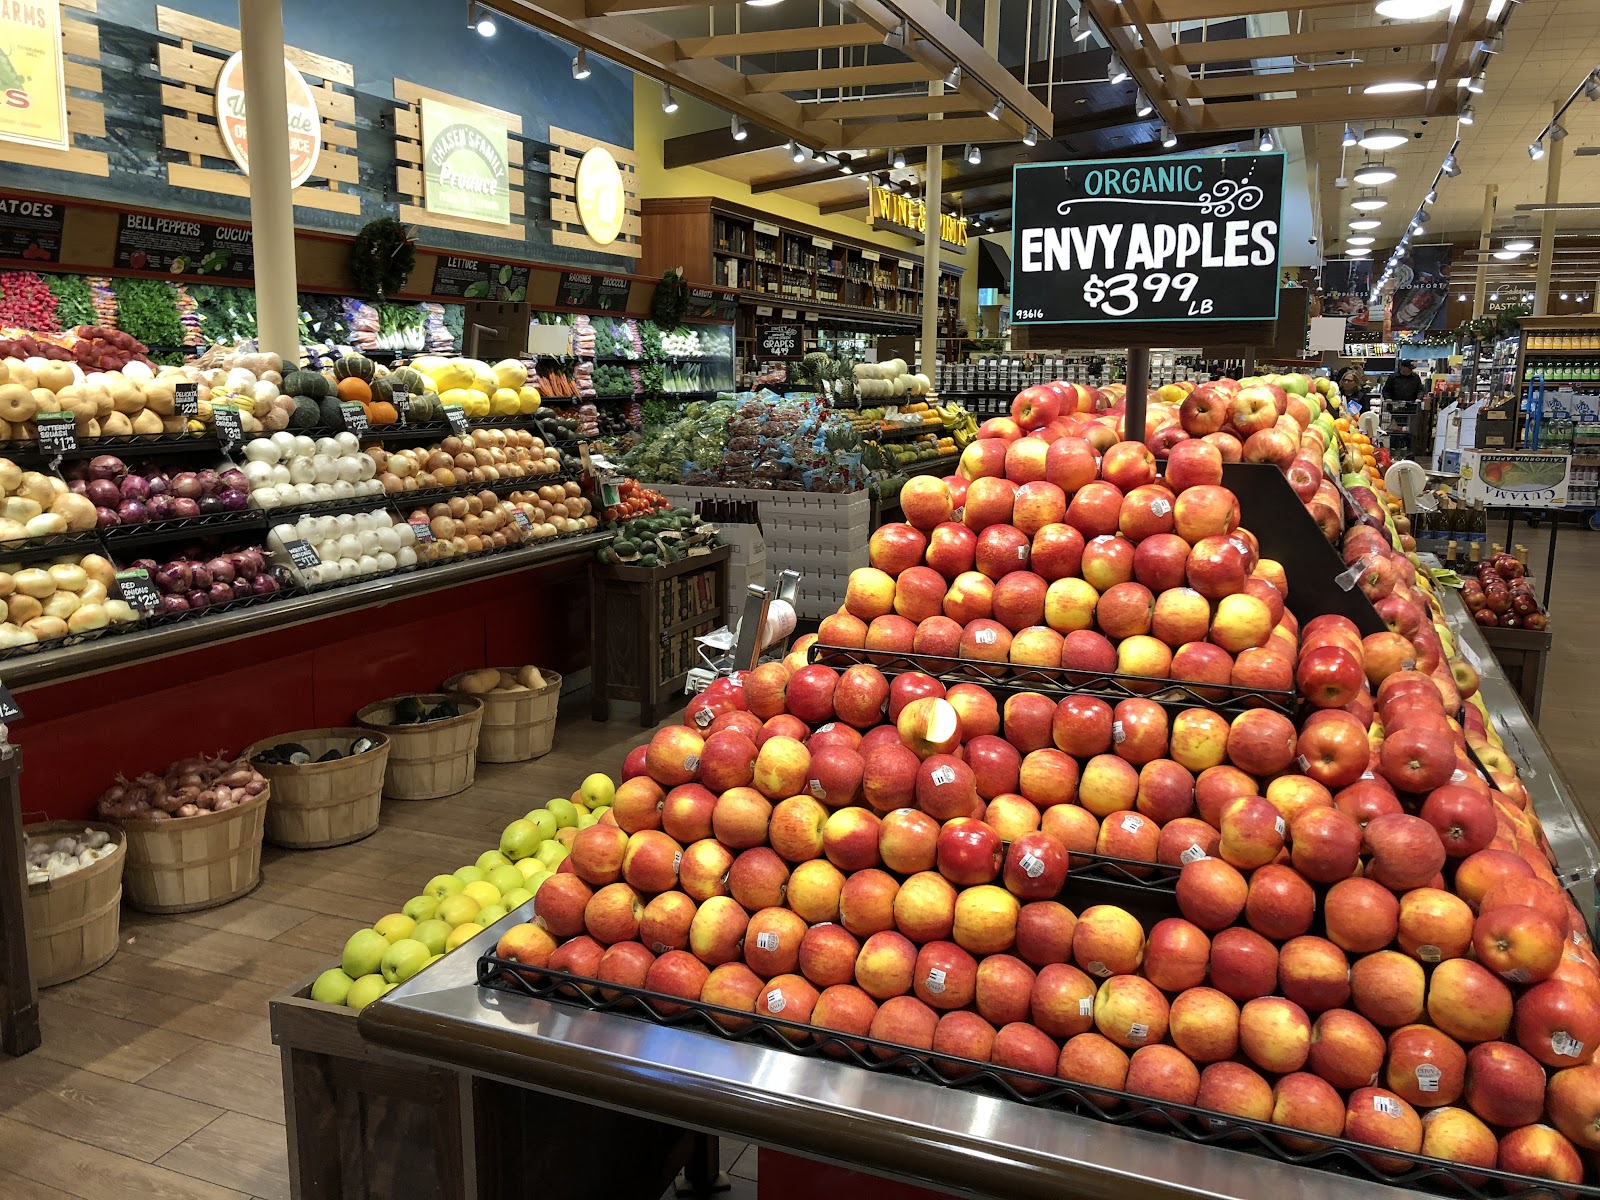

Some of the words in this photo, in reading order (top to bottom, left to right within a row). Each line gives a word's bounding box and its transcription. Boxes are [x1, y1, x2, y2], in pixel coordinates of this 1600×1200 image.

[432, 128, 475, 167] CHASEN'S
[475, 134, 504, 178] FAMILY
[1084, 164, 1203, 196] ORGANIC
[877, 187, 914, 230] WINE
[940, 213, 968, 247] IRITS
[127, 214, 155, 231] BELL
[155, 218, 201, 237] PEPPERS
[1021, 223, 1124, 272] ENVY
[1124, 220, 1278, 271] APPLES
[447, 256, 478, 271] LETTUCE
[602, 276, 627, 289] BROCCOLI
[1400, 282, 1443, 290] COMFORT
[692, 288, 714, 300] CARROTS
[723, 293, 735, 302] KALE
[1188, 299, 1214, 316] LB
[1015, 308, 1045, 321] 93616
[763, 339, 795, 349] GRAPES
[37, 423, 76, 432] BUTTERNUT
[39, 430, 69, 439] SQUASH
[120, 581, 136, 590] RED
[123, 586, 149, 597] ONIONS
